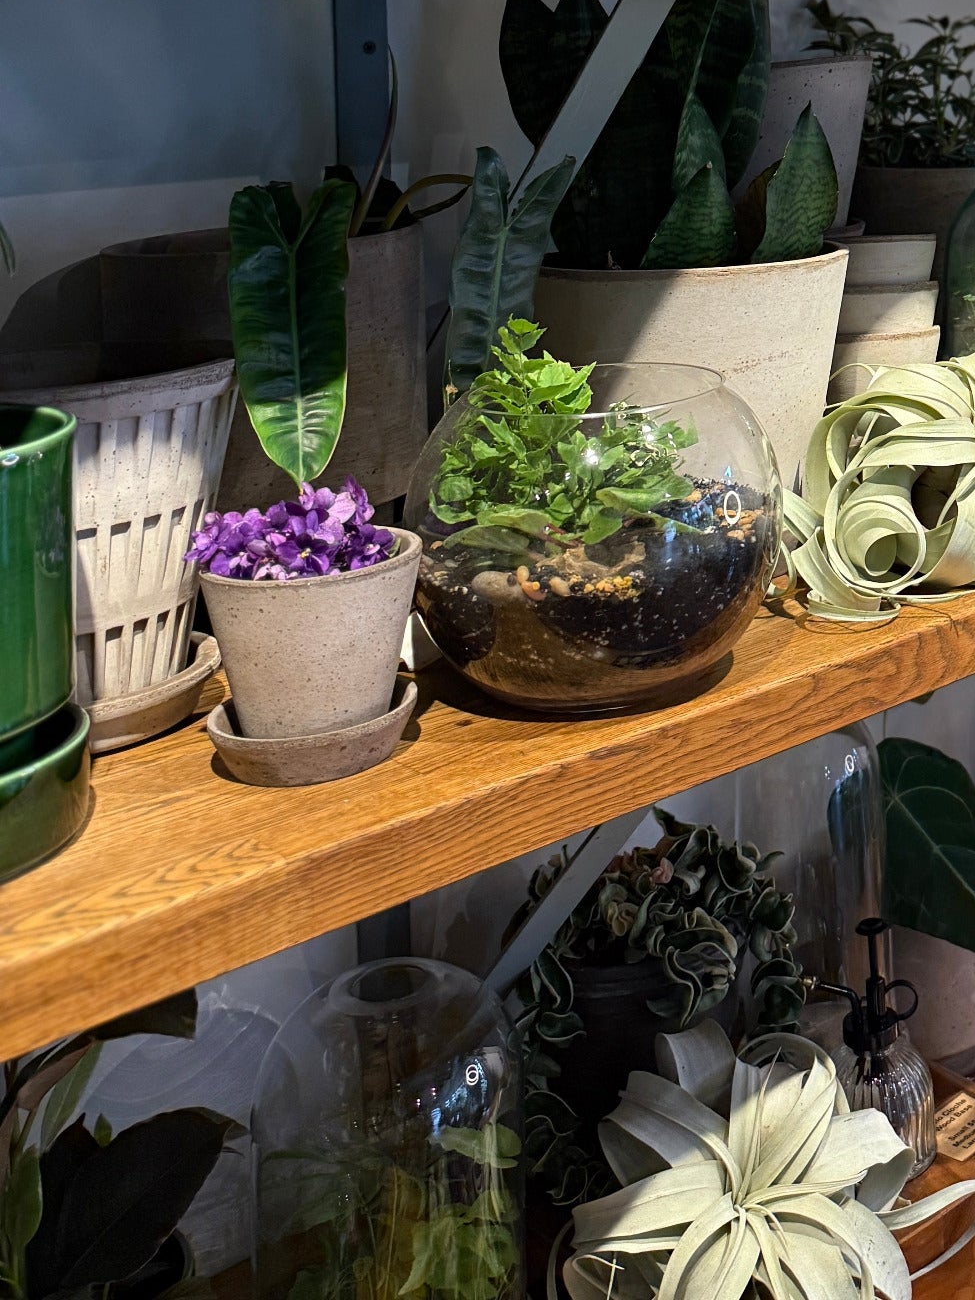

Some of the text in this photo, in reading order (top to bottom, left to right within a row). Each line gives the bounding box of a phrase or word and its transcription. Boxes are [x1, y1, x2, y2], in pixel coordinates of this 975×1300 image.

[942, 1099, 966, 1116] Cloche
[954, 1103, 973, 1118] Base
[948, 1125, 969, 1141] Small
